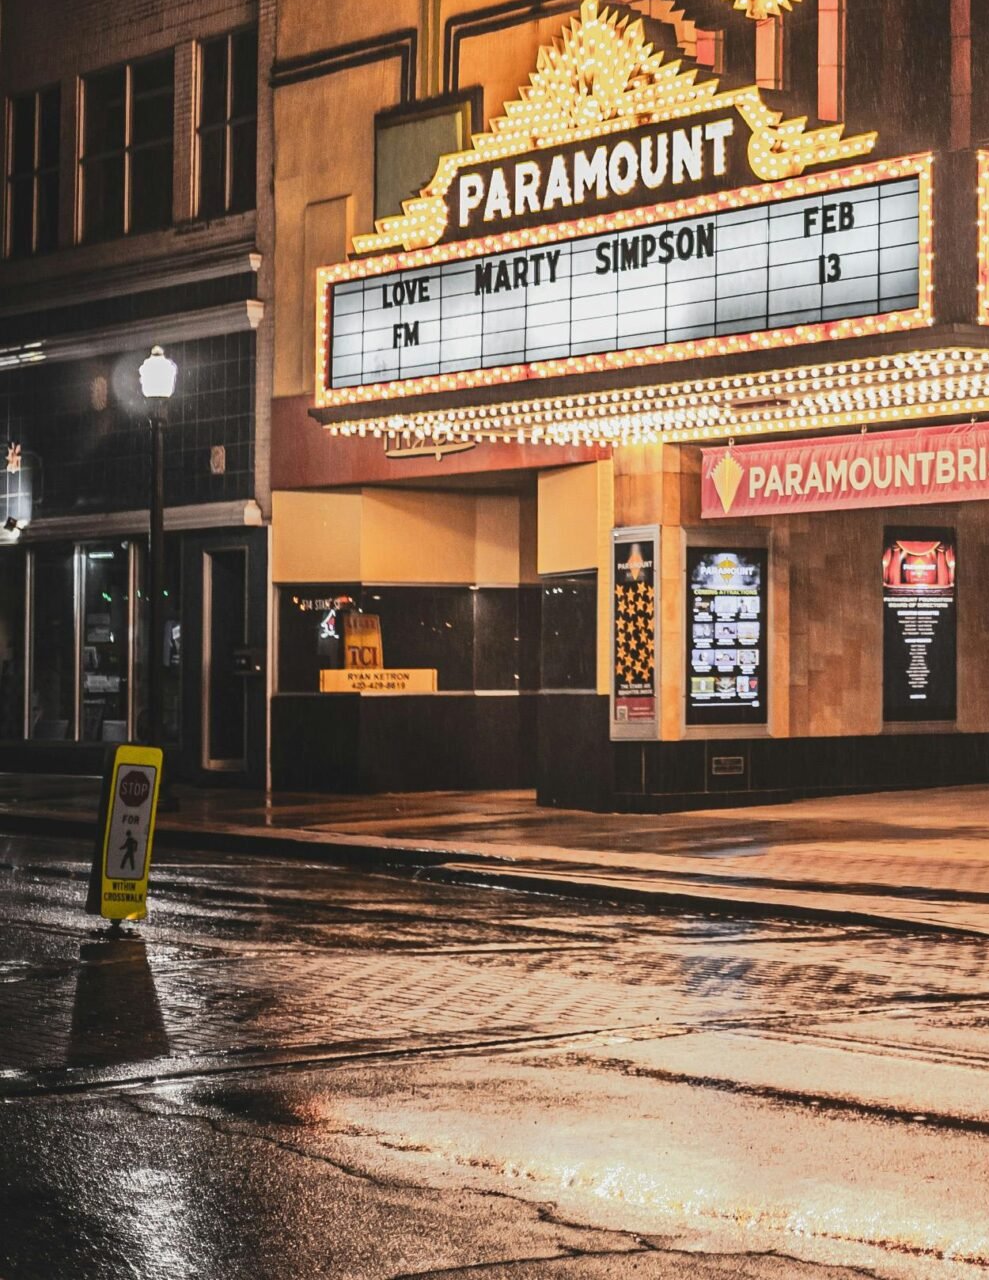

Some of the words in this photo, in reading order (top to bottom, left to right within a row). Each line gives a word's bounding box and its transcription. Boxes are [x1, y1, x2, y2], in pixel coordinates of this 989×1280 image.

[457, 120, 734, 226] PARAMOUNT
[382, 276, 430, 308] LOVE
[474, 250, 560, 295] MARTY
[595, 223, 715, 275] SIMPSON
[803, 202, 854, 238] FEB
[393, 322, 419, 349] FM
[818, 253, 841, 284] 13
[347, 645, 379, 667] TCI
[347, 673, 371, 681] RYAN
[374, 672, 410, 681] KETRON
[120, 781, 149, 797] STOP
[121, 814, 140, 826] FOR
[112, 881, 137, 891] WITHIN
[103, 891, 144, 903] CROSSWALK
